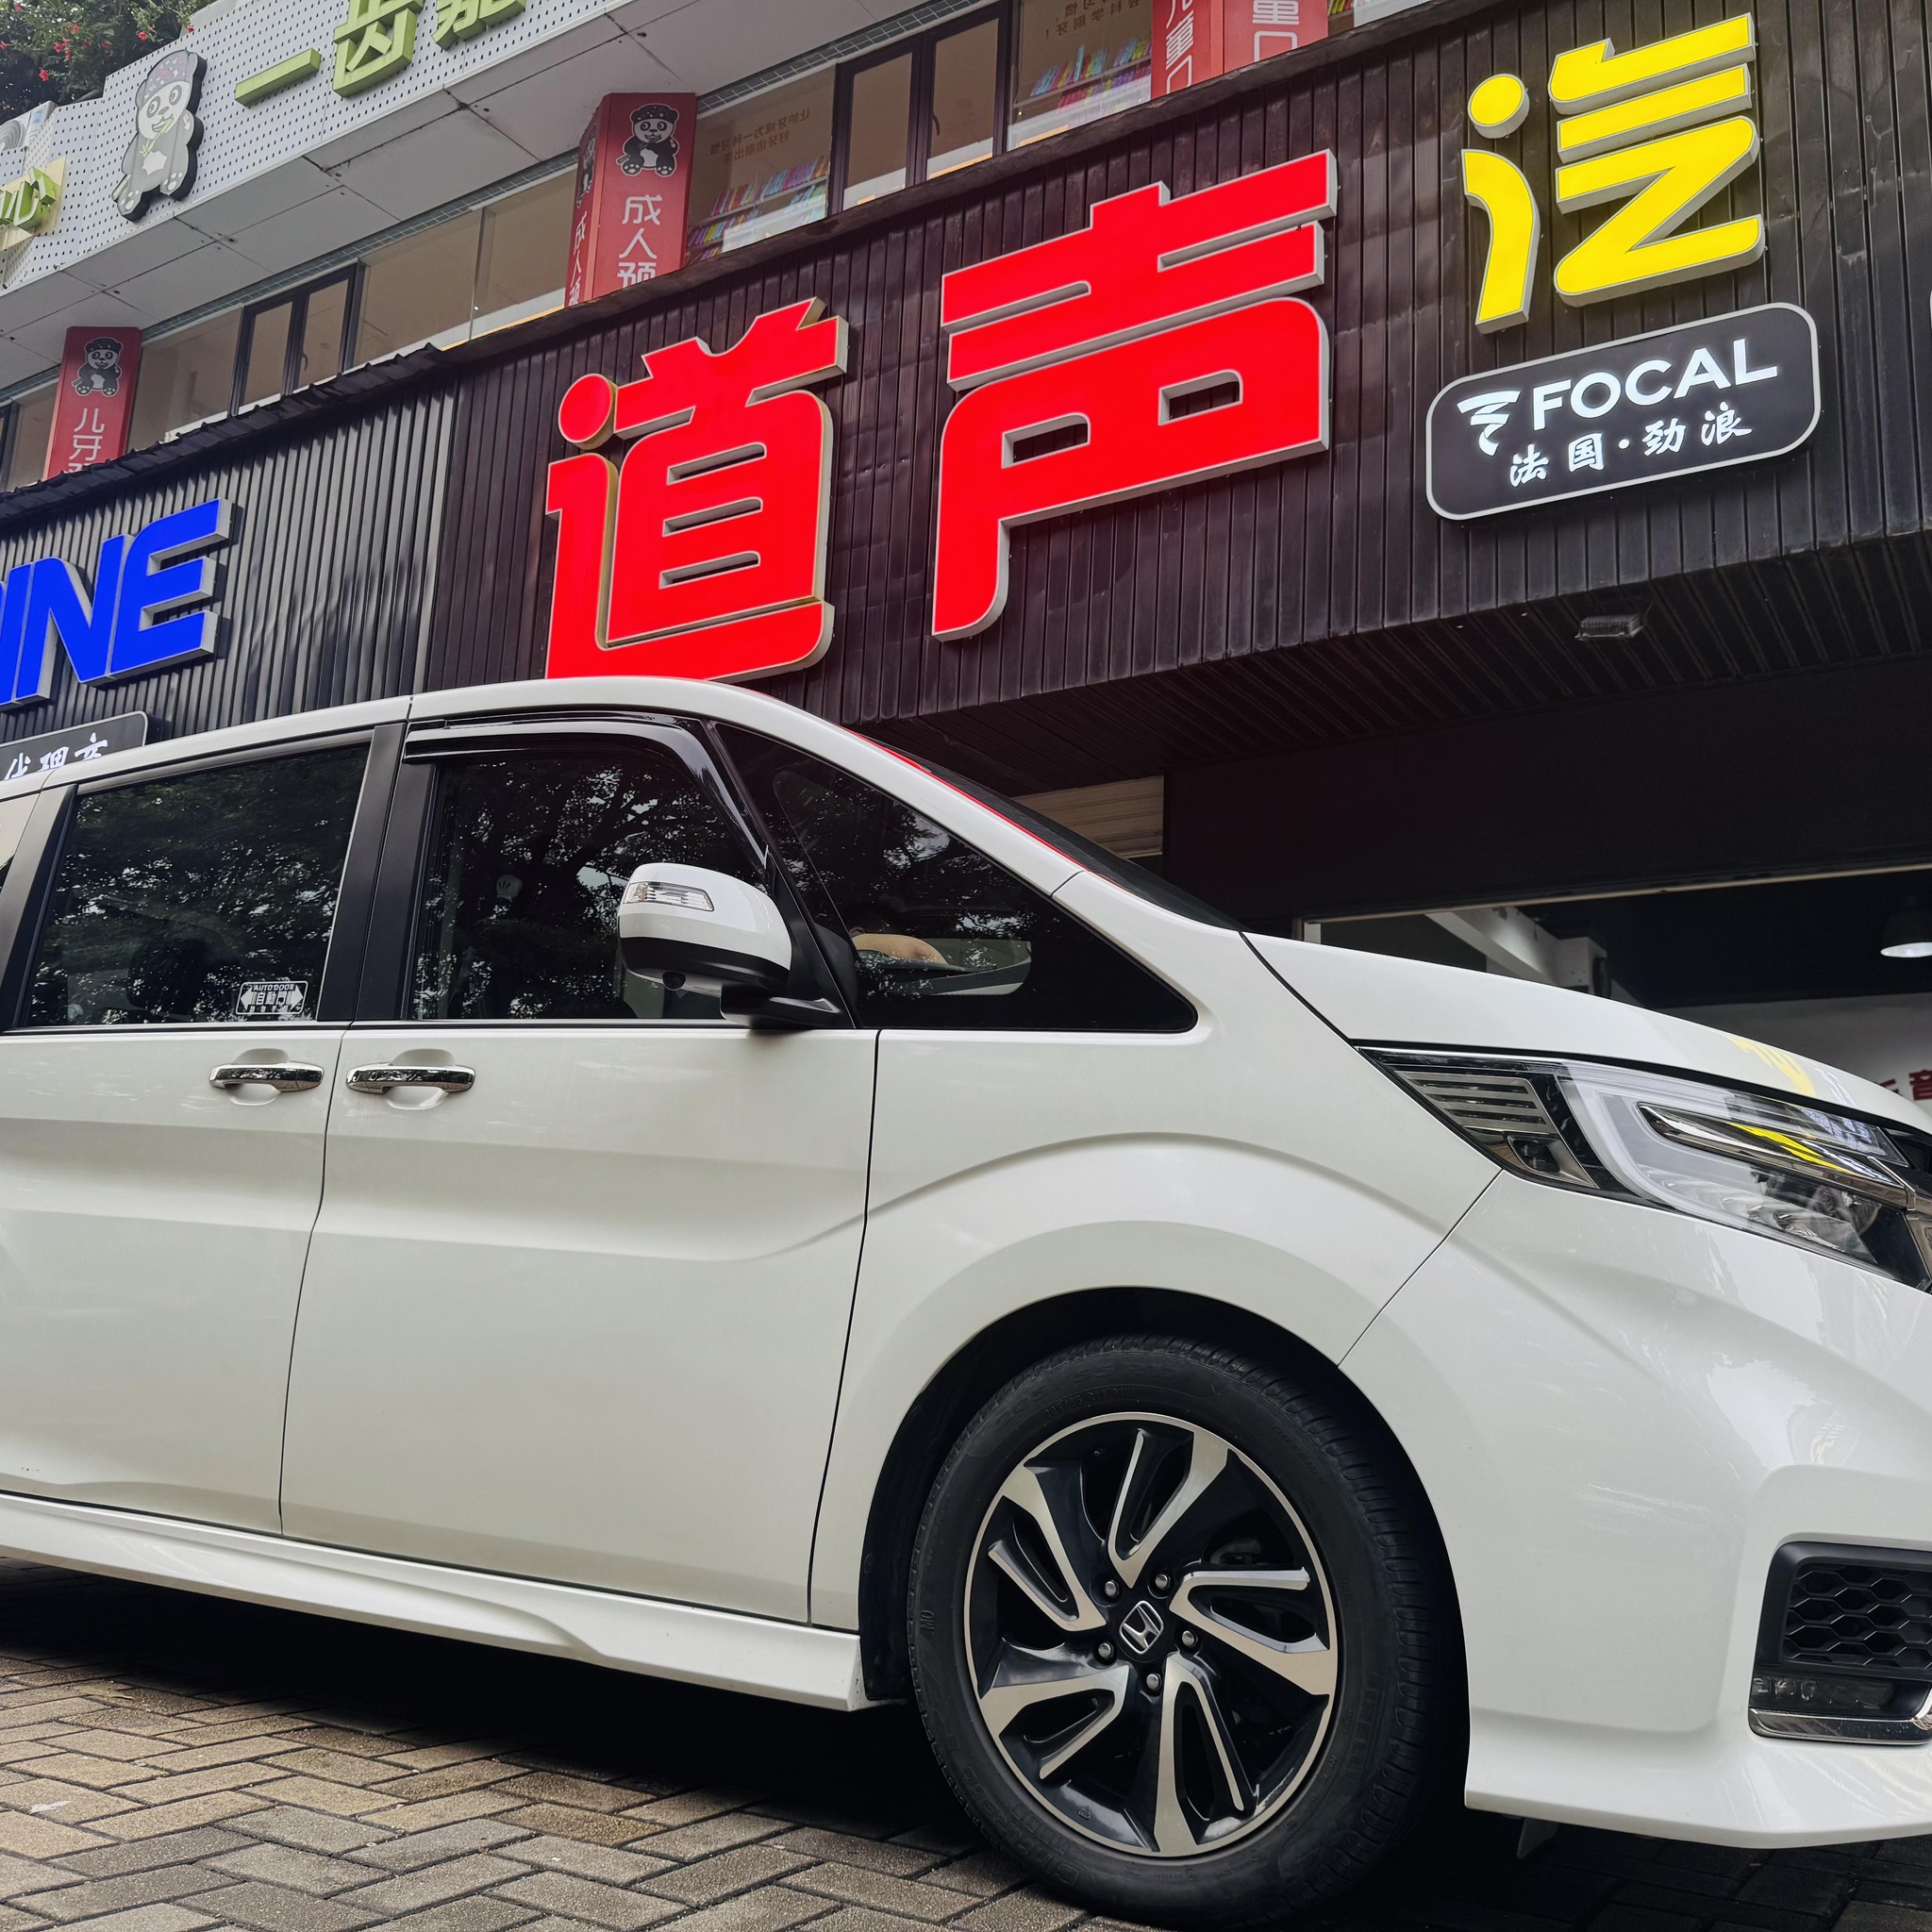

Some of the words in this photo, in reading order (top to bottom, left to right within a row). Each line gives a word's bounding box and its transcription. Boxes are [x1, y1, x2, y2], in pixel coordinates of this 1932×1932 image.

[616, 193, 663, 289] 成人预
[1533, 339, 1778, 431] FOCAL
[1509, 401, 1753, 488] 法国·劲浪
[0, 498, 226, 707] INE
